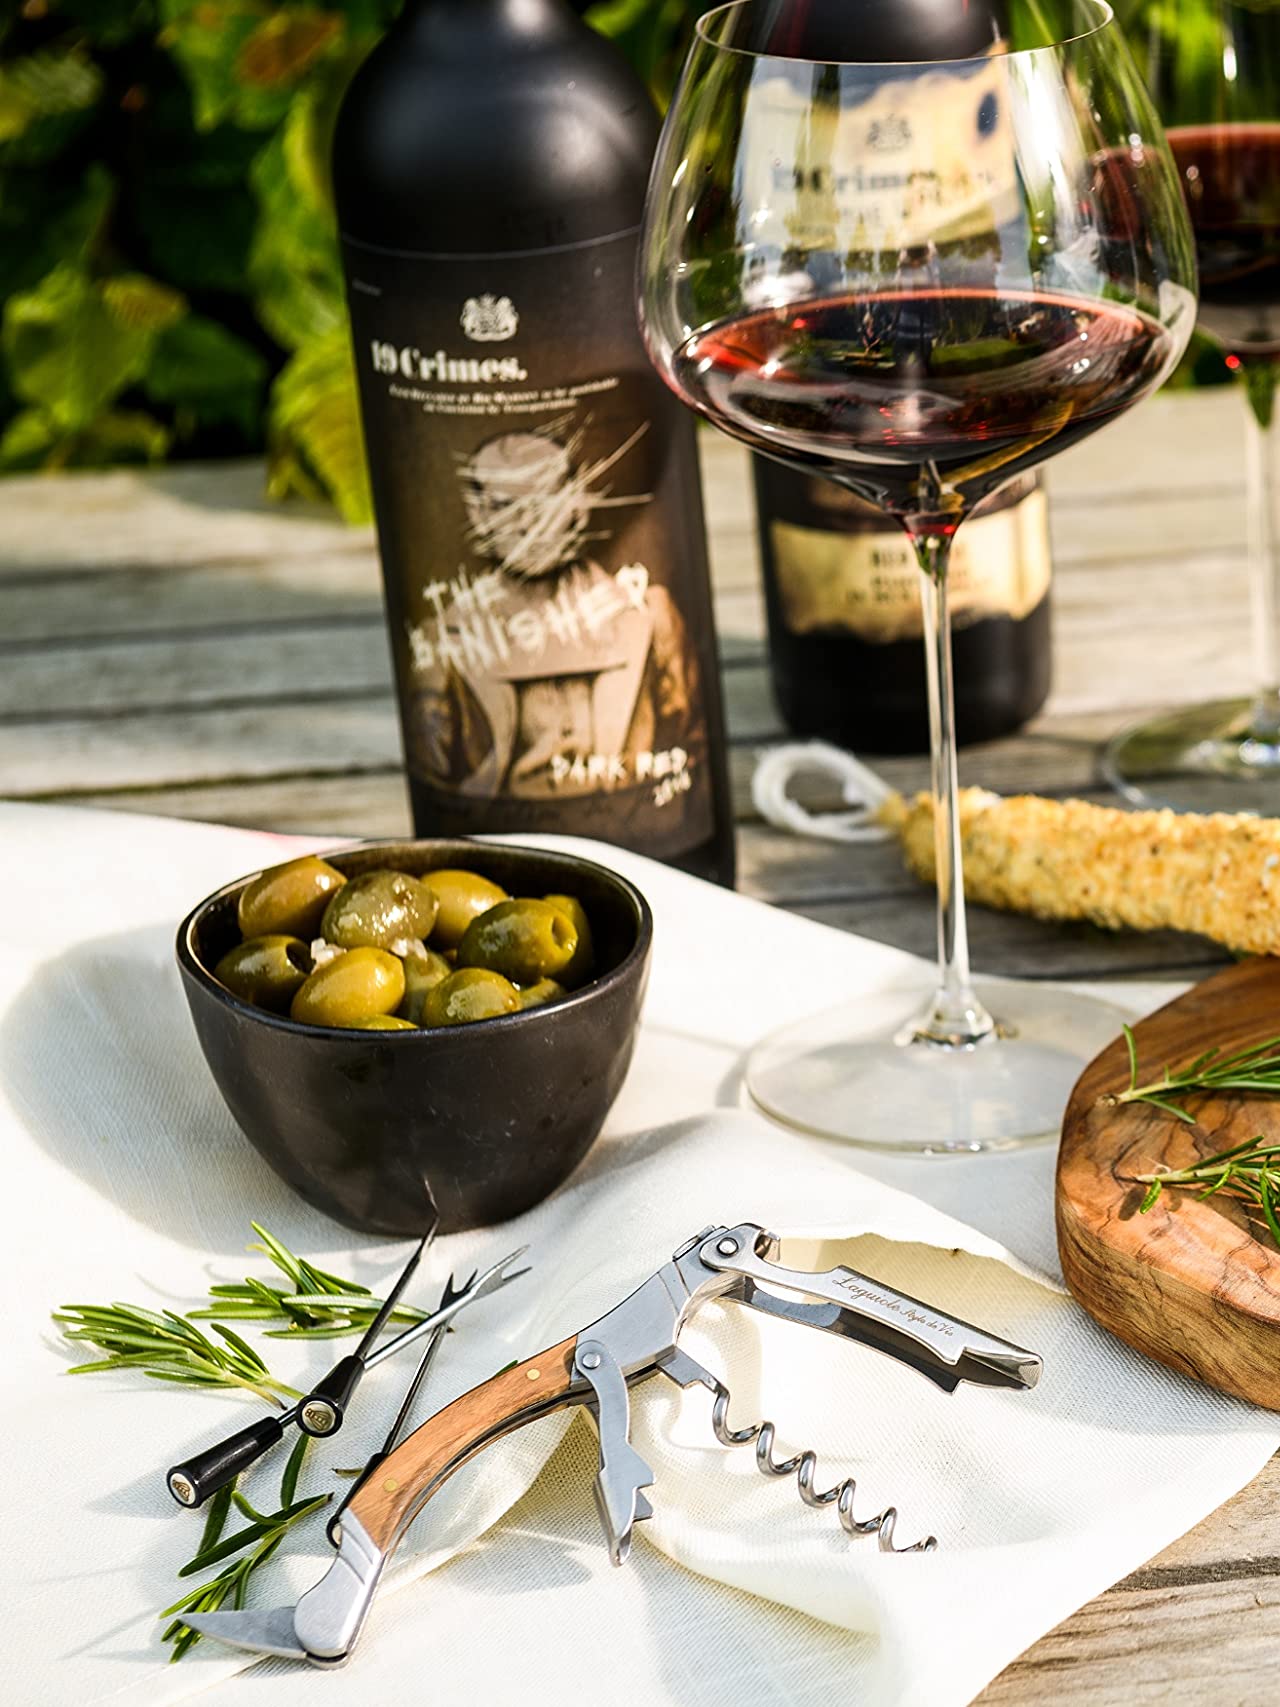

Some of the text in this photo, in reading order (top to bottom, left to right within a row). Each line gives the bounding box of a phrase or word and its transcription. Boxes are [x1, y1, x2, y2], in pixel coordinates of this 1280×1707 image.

[635, 746, 689, 783] RED
[832, 1275, 901, 1312] Laguiole
[899, 1308, 927, 1323] Style
[926, 1319, 938, 1329] de
